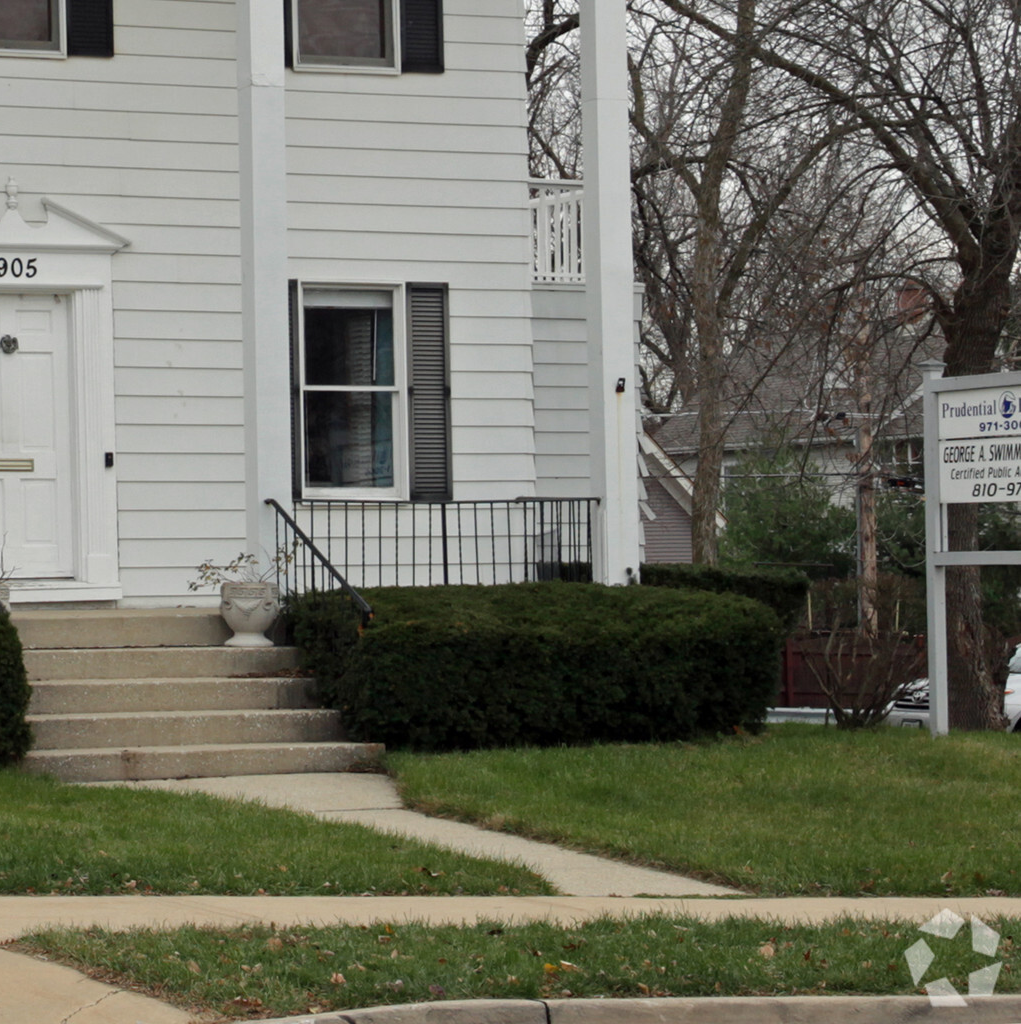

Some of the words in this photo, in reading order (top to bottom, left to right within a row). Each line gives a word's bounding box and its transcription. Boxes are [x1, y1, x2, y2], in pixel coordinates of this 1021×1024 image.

[942, 399, 997, 419] Prudential
[979, 420, 1021, 432] 971-30
[943, 445, 976, 464] GEORGE
[978, 445, 987, 462] A.
[950, 467, 985, 480] Certified
[988, 466, 1012, 479] Public
[972, 482, 1021, 497] 810-97
